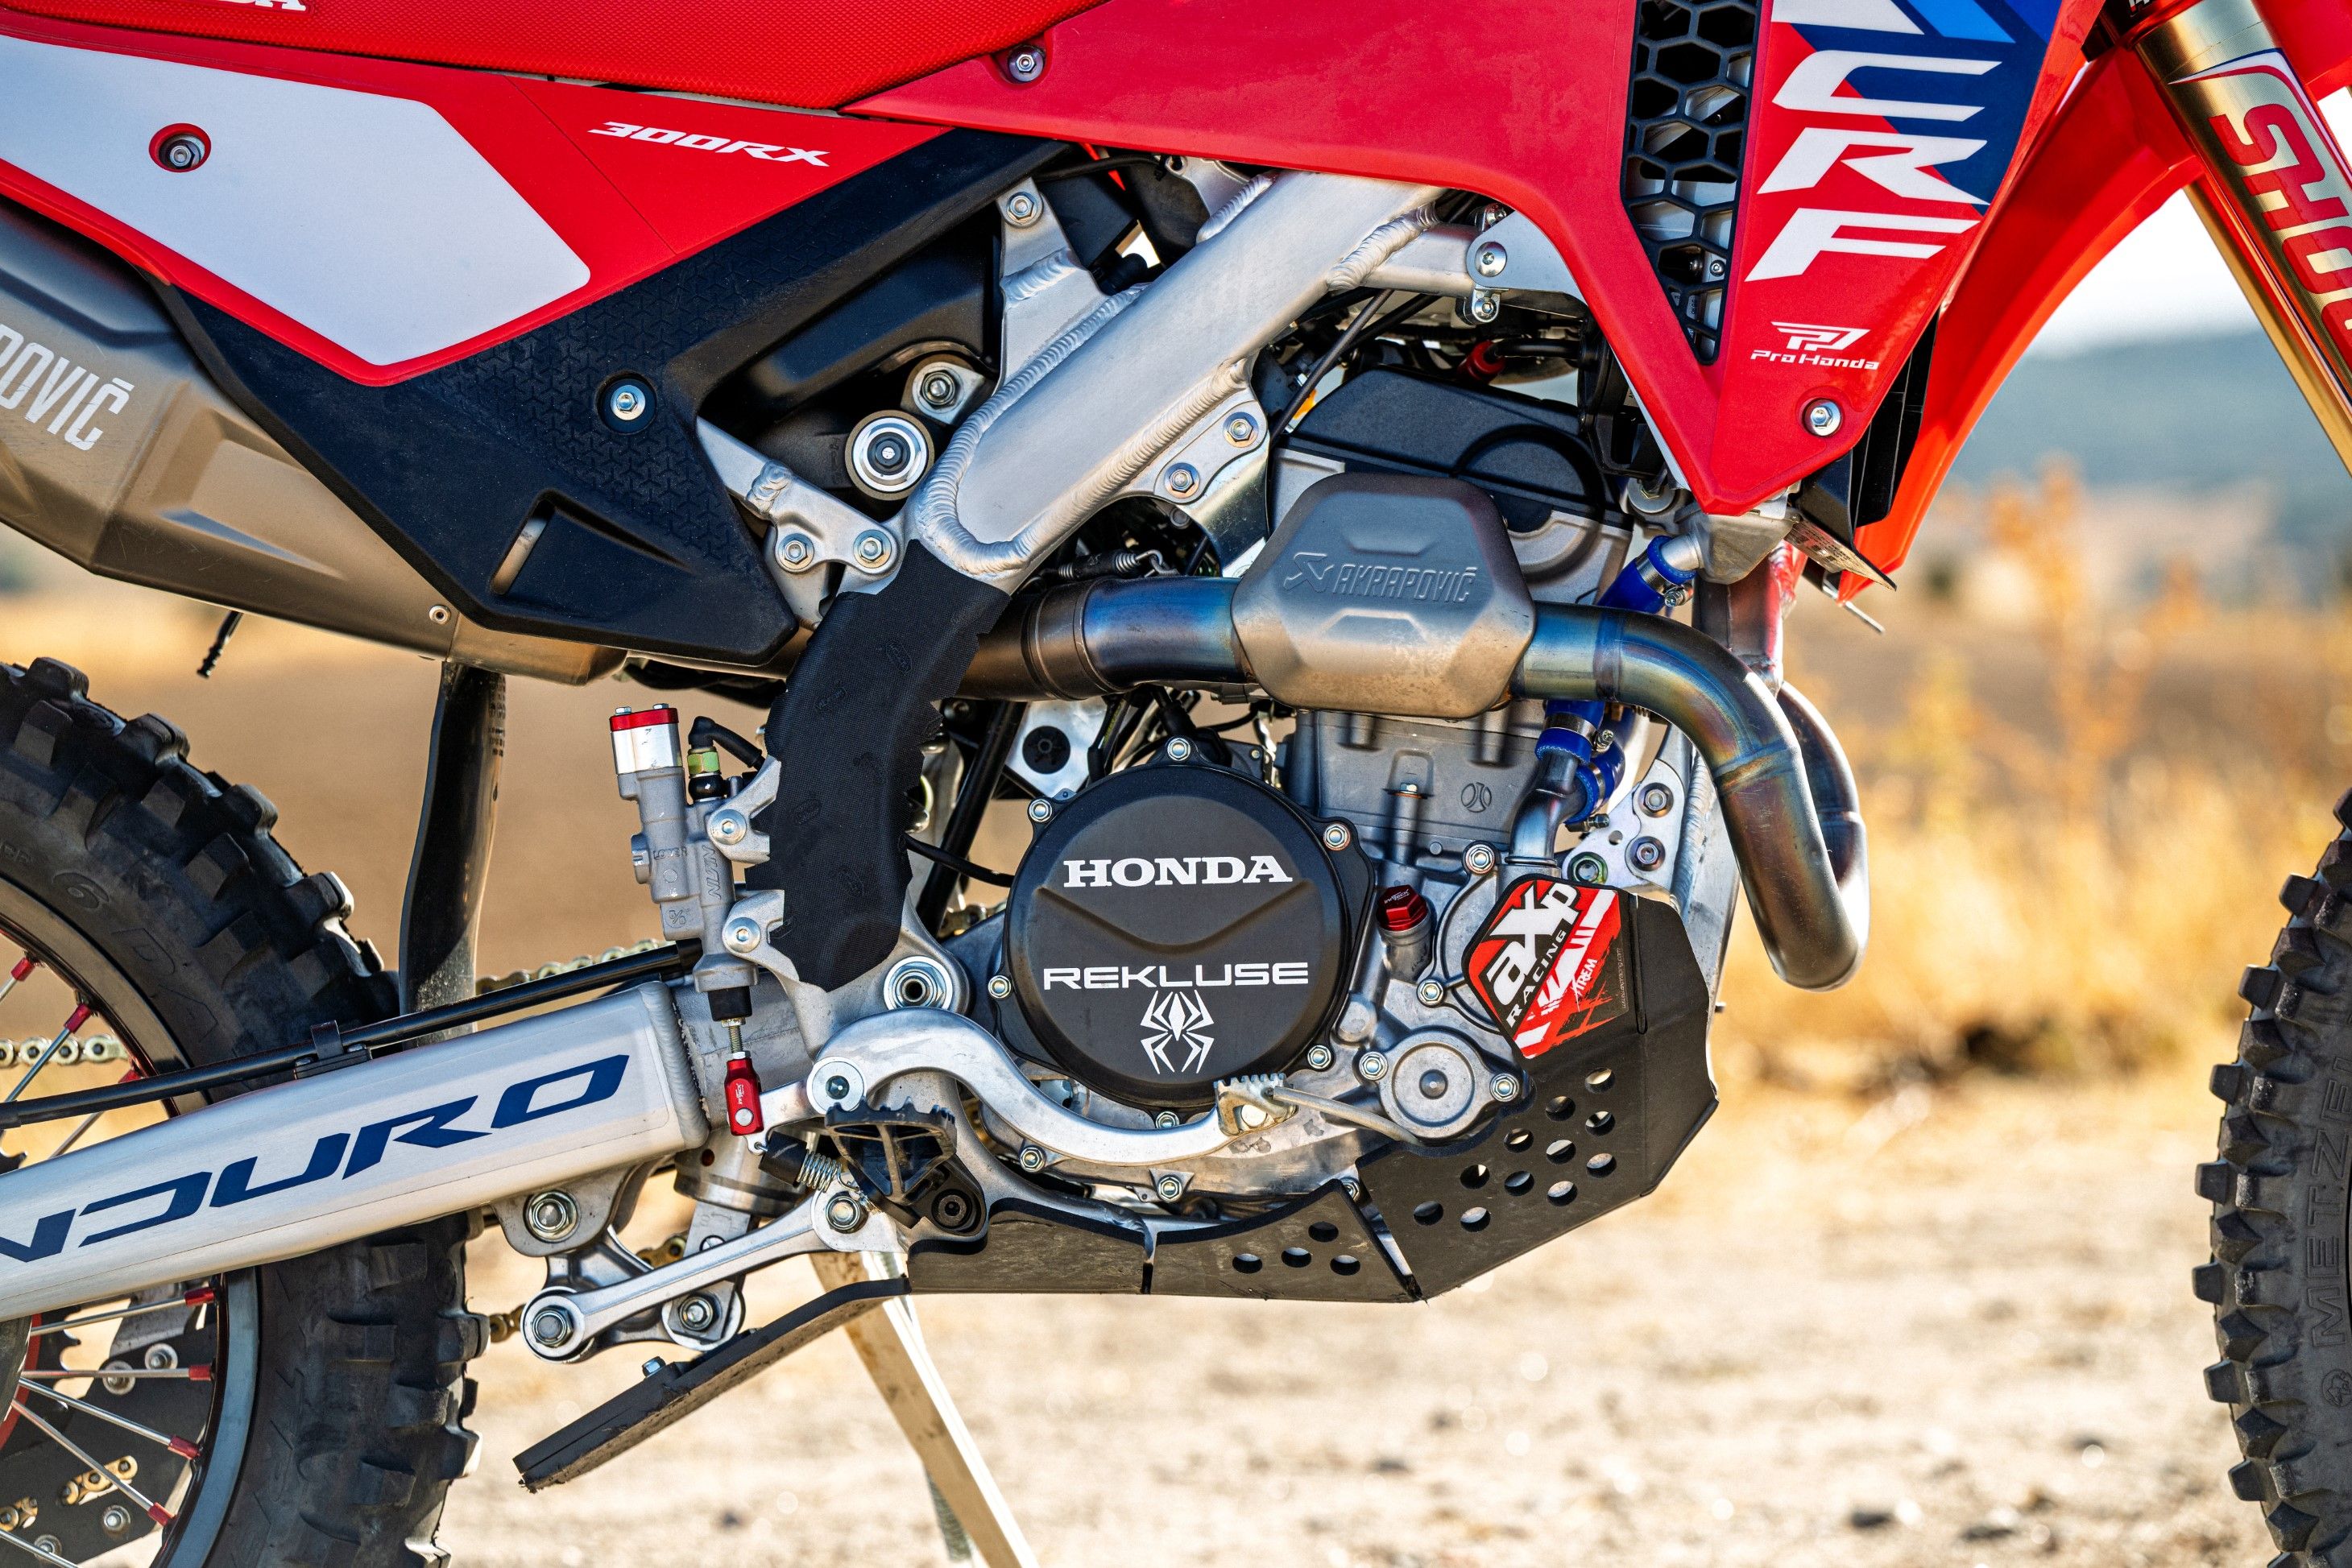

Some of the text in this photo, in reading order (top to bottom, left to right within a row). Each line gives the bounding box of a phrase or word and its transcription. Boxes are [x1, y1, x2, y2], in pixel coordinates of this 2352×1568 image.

[587, 121, 830, 168] 300RX
[1744, 49, 2003, 282] CRF
[1063, 855, 1294, 887] HONDA
[1044, 962, 1309, 990] REKLUSE
[1505, 929, 1567, 1028] RACING
